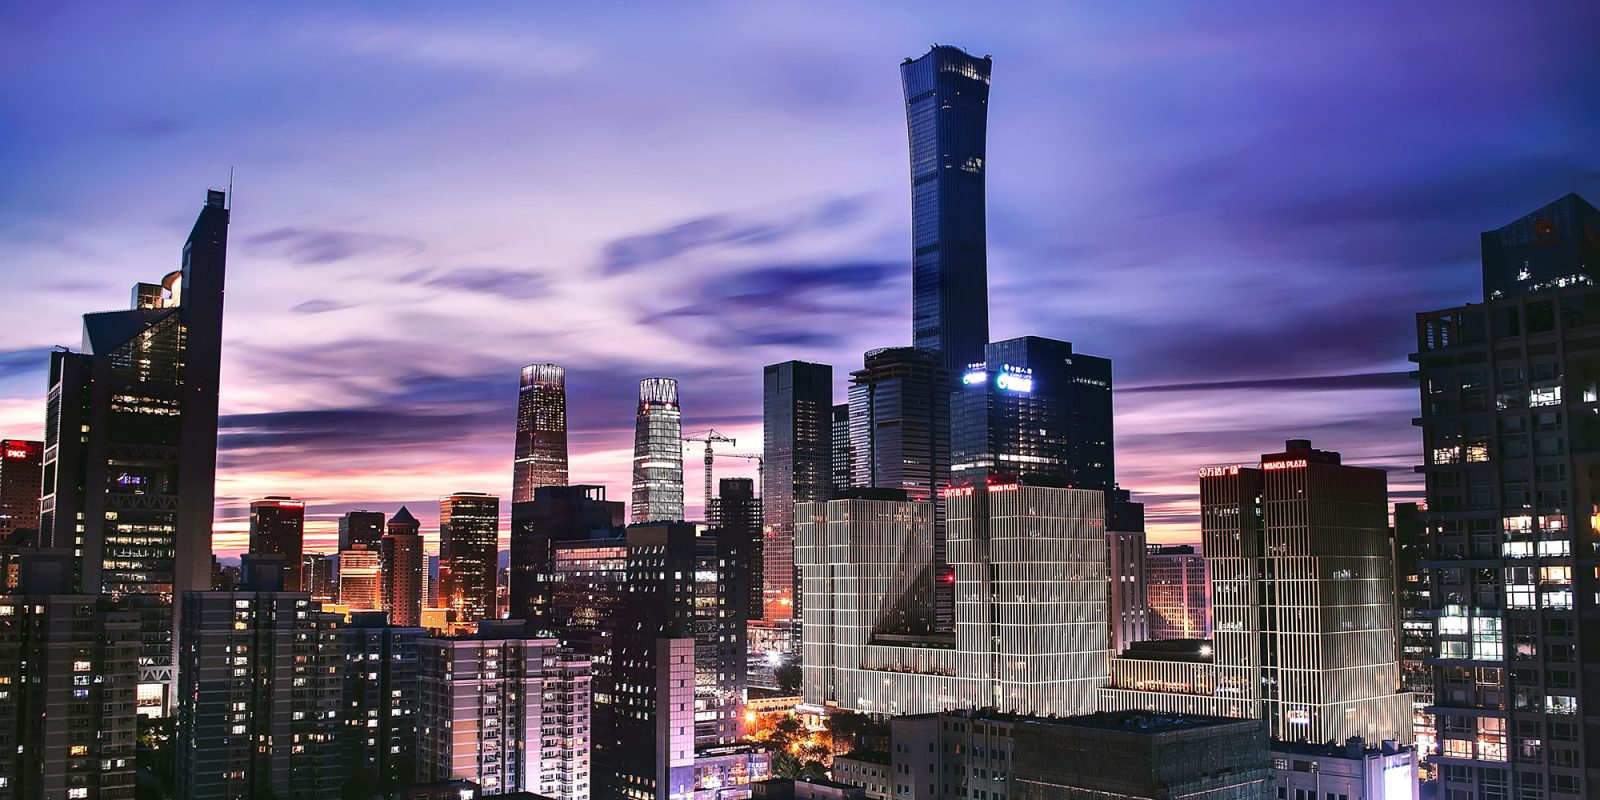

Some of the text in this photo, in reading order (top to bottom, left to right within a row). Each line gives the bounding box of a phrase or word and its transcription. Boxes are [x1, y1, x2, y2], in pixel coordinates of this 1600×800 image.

[8, 450, 26, 458] PICC
[1264, 460, 1307, 470] WANDA PLAZA
